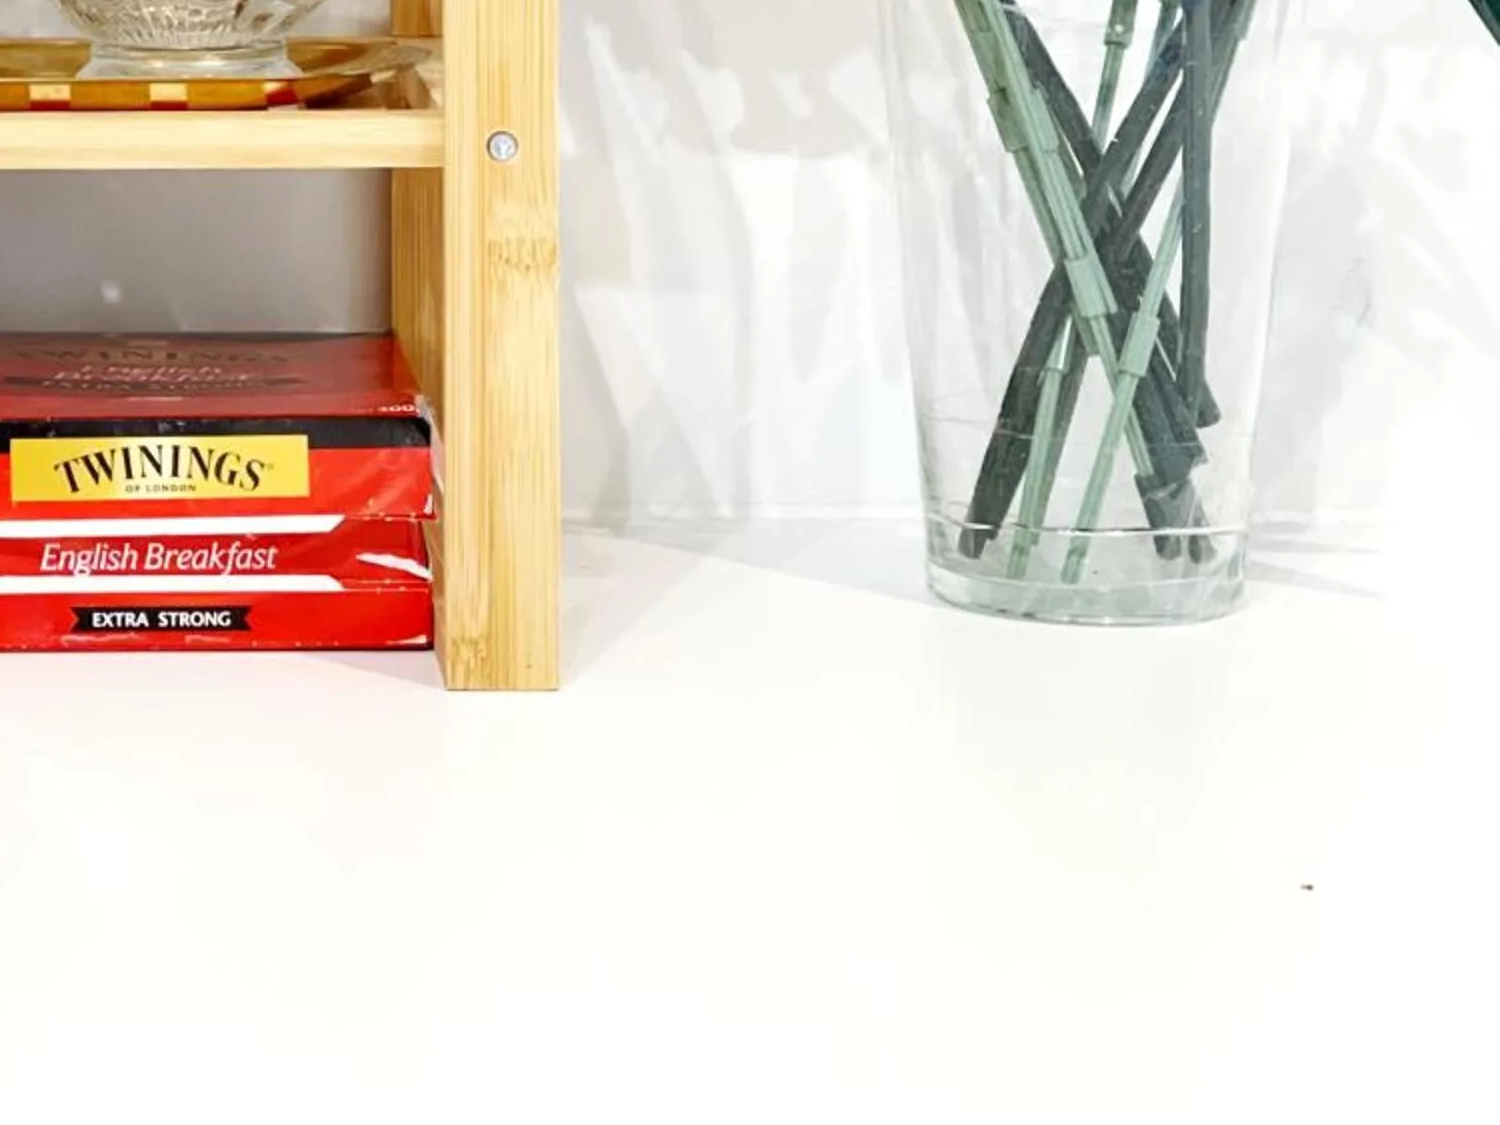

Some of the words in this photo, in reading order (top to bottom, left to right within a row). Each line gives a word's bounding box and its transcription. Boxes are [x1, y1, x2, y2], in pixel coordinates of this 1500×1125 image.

[124, 483, 141, 494] OF
[145, 482, 198, 493] LONDON
[40, 542, 140, 577] English
[143, 540, 279, 577] Breakfast
[91, 611, 150, 629] EXTRA
[157, 610, 232, 628] STRONG
